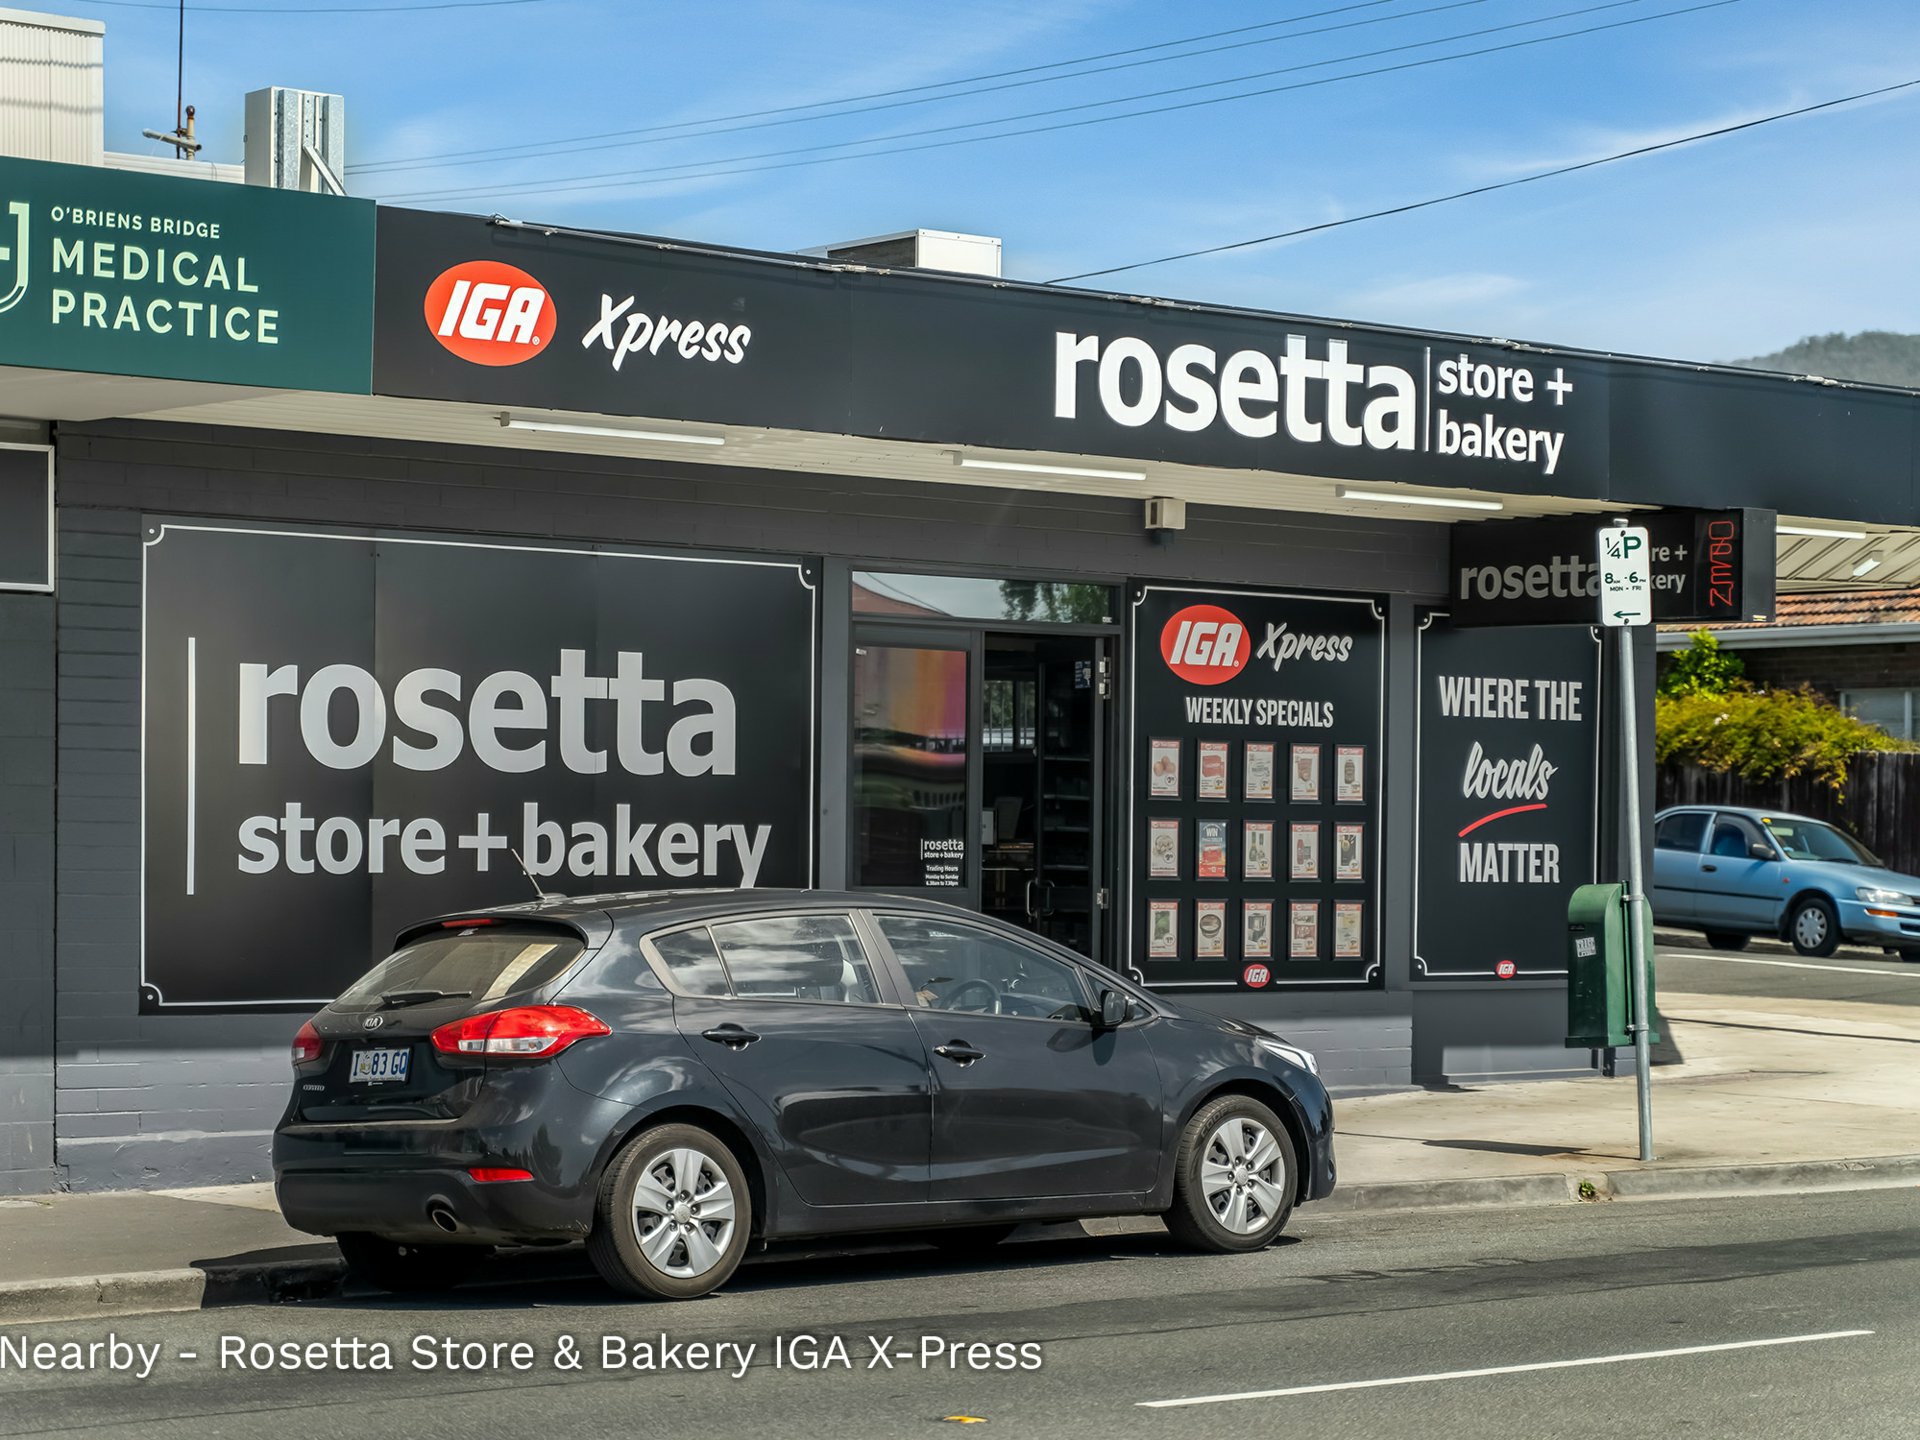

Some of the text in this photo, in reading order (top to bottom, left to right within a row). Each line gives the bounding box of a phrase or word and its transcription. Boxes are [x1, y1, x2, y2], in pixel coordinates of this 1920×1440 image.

[51, 206, 221, 239] O'BRIENS BRIDGE
[52, 238, 259, 293] MEDICAL
[52, 289, 279, 344] PRACTICE
[437, 279, 751, 372] IGA Xpress
[1055, 331, 1417, 451] rosetta
[1437, 353, 1533, 402] store
[1437, 409, 1564, 475] bakery
[1170, 620, 1353, 672] IGA Xpress
[238, 648, 736, 777] rosetta
[1185, 697, 1334, 728] WEEKLY SPECIALS
[1439, 676, 1583, 721] WHERE THE
[1463, 741, 1559, 800] locals
[238, 802, 445, 874] store
[523, 802, 772, 888] bakery
[924, 839, 964, 850] rosetta
[1459, 843, 1560, 883] MATTER
[1247, 968, 1268, 983] IGA
[1498, 963, 1515, 975] IGA
[364, 1017, 379, 1027] KIA
